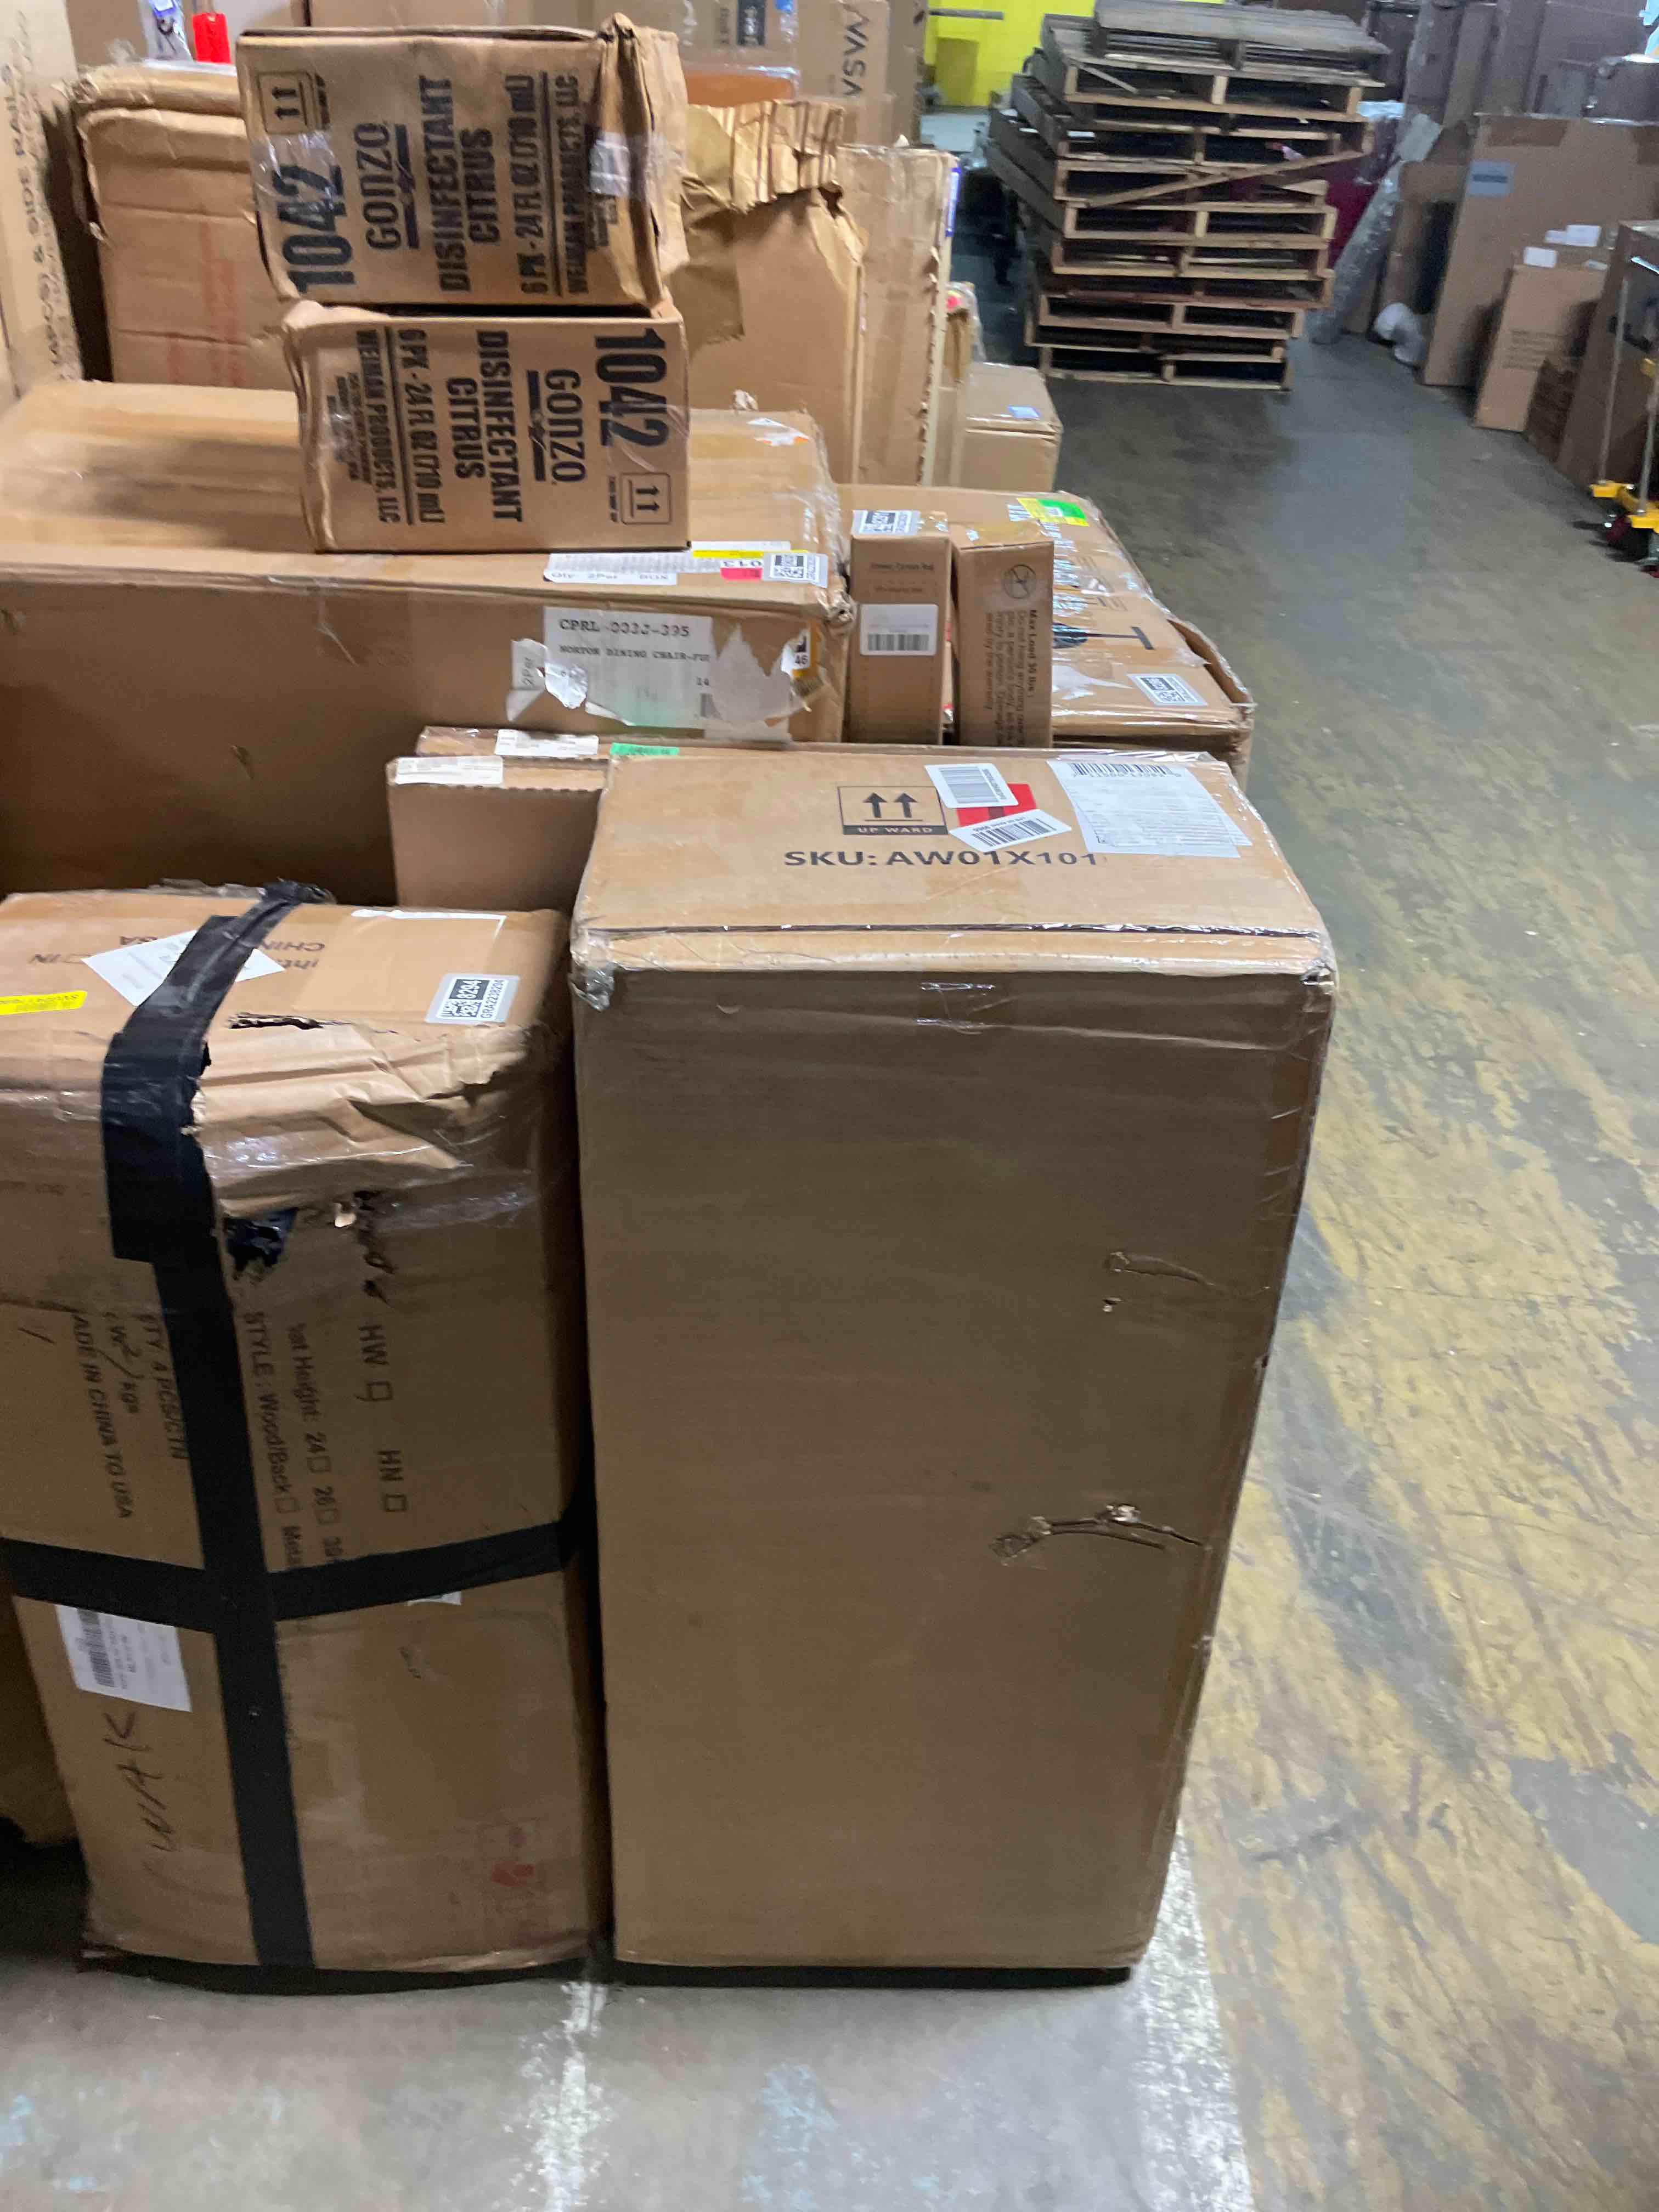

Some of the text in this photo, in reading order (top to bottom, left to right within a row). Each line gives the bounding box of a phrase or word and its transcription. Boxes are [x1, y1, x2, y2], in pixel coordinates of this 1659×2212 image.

[556, 74, 579, 107] LLC
[419, 75, 471, 291] DISINFECTANT
[460, 128, 500, 243] CITRUS
[272, 165, 356, 293] 1042
[515, 213, 544, 238] 24
[516, 252, 546, 278] PK
[400, 344, 430, 369] PK
[405, 383, 433, 405] 24
[595, 328, 669, 447] 1042
[447, 377, 486, 479] CITRUS
[477, 330, 523, 522] DISINFECTANT
[377, 496, 401, 523] LLC
[606, 648, 647, 659] DINING
[857, 826, 934, 834] UP WARD
[456, 980, 482, 999] 8294
[358, 1324, 390, 1366] HW
[80, 1363, 103, 1383] IN
[88, 1388, 118, 1446] CHINA
[105, 1451, 127, 1476] TO
[377, 1449, 404, 1482] HN
[110, 1481, 134, 1519] USA
